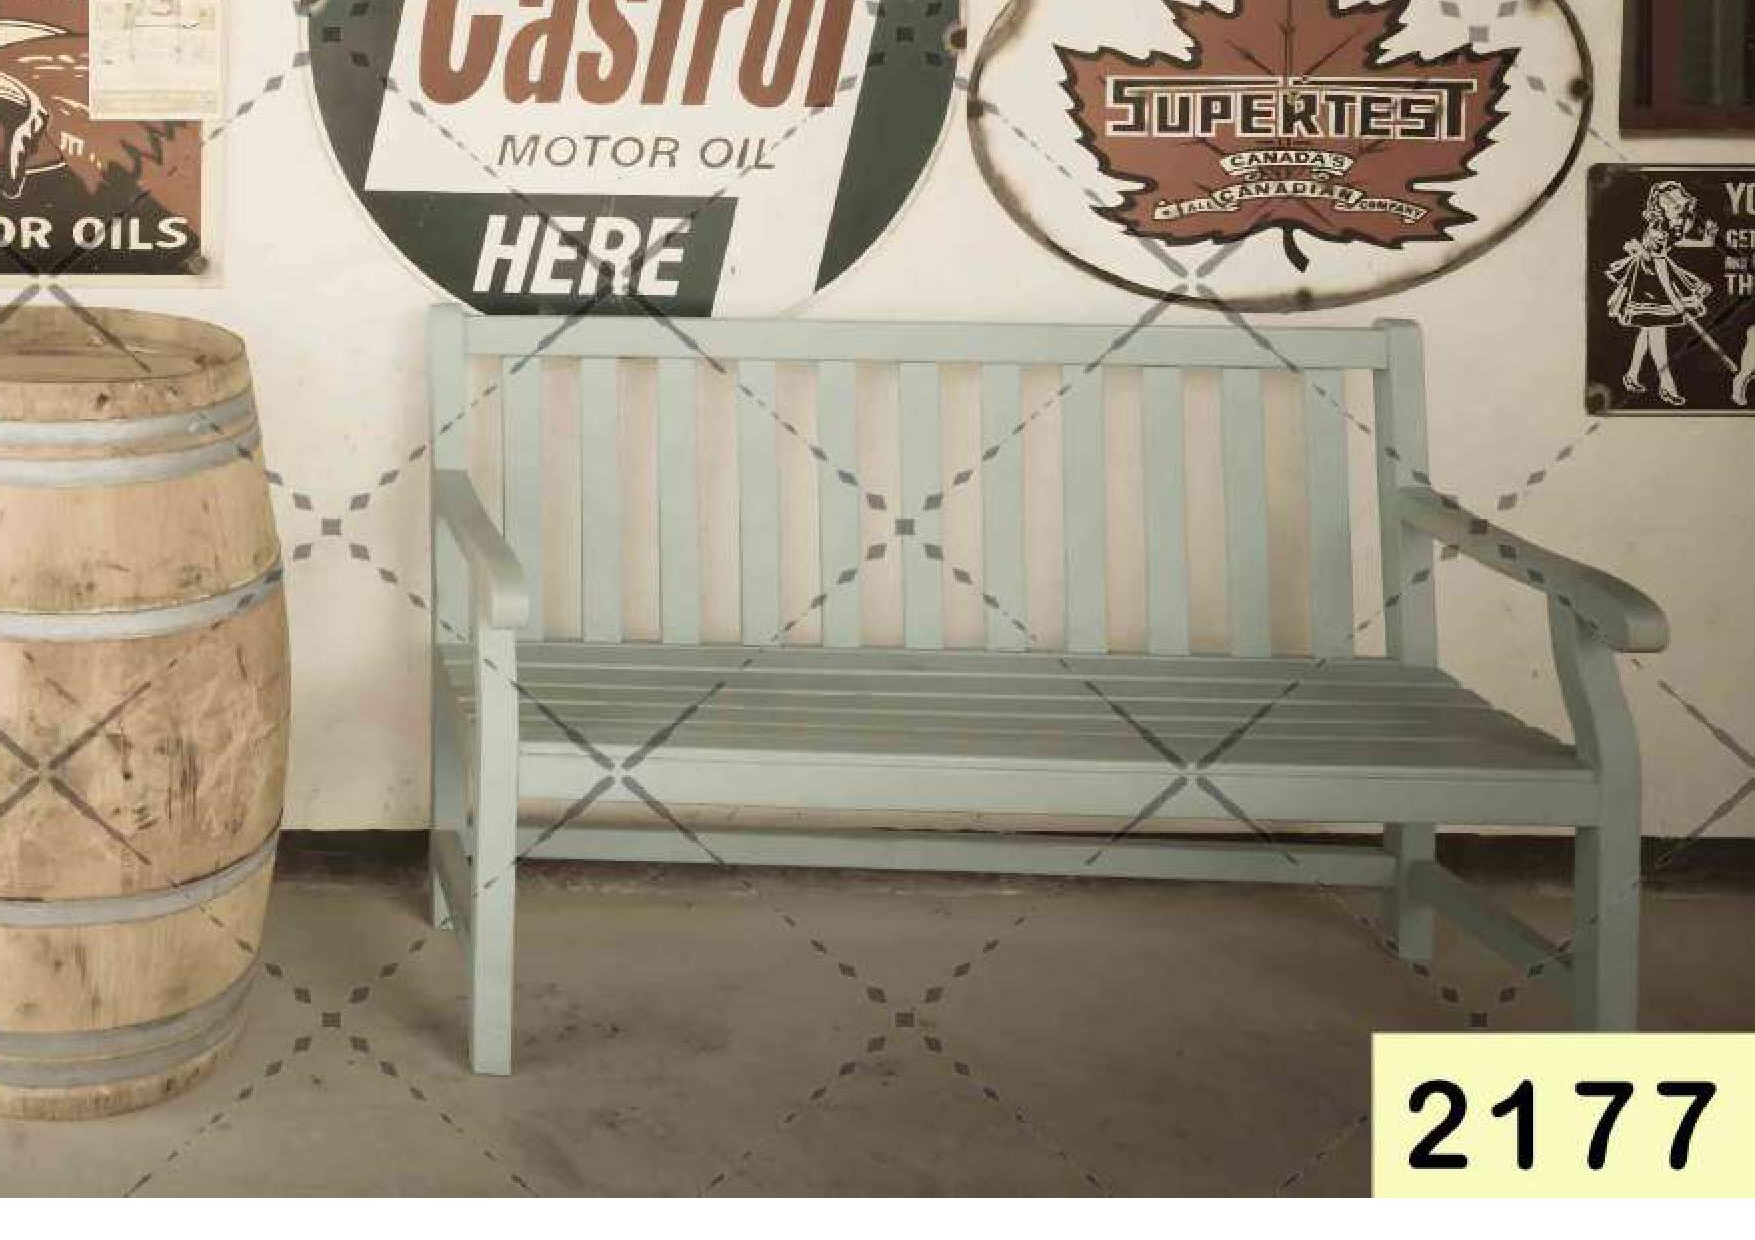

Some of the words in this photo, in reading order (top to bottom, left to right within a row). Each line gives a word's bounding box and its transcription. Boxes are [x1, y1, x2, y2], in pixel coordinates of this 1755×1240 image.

[1105, 74, 1479, 142] SUPERTEST
[496, 133, 681, 170] MOTOR
[699, 136, 778, 171] OIL
[71, 215, 190, 251] OILS
[472, 213, 693, 297] HERE
